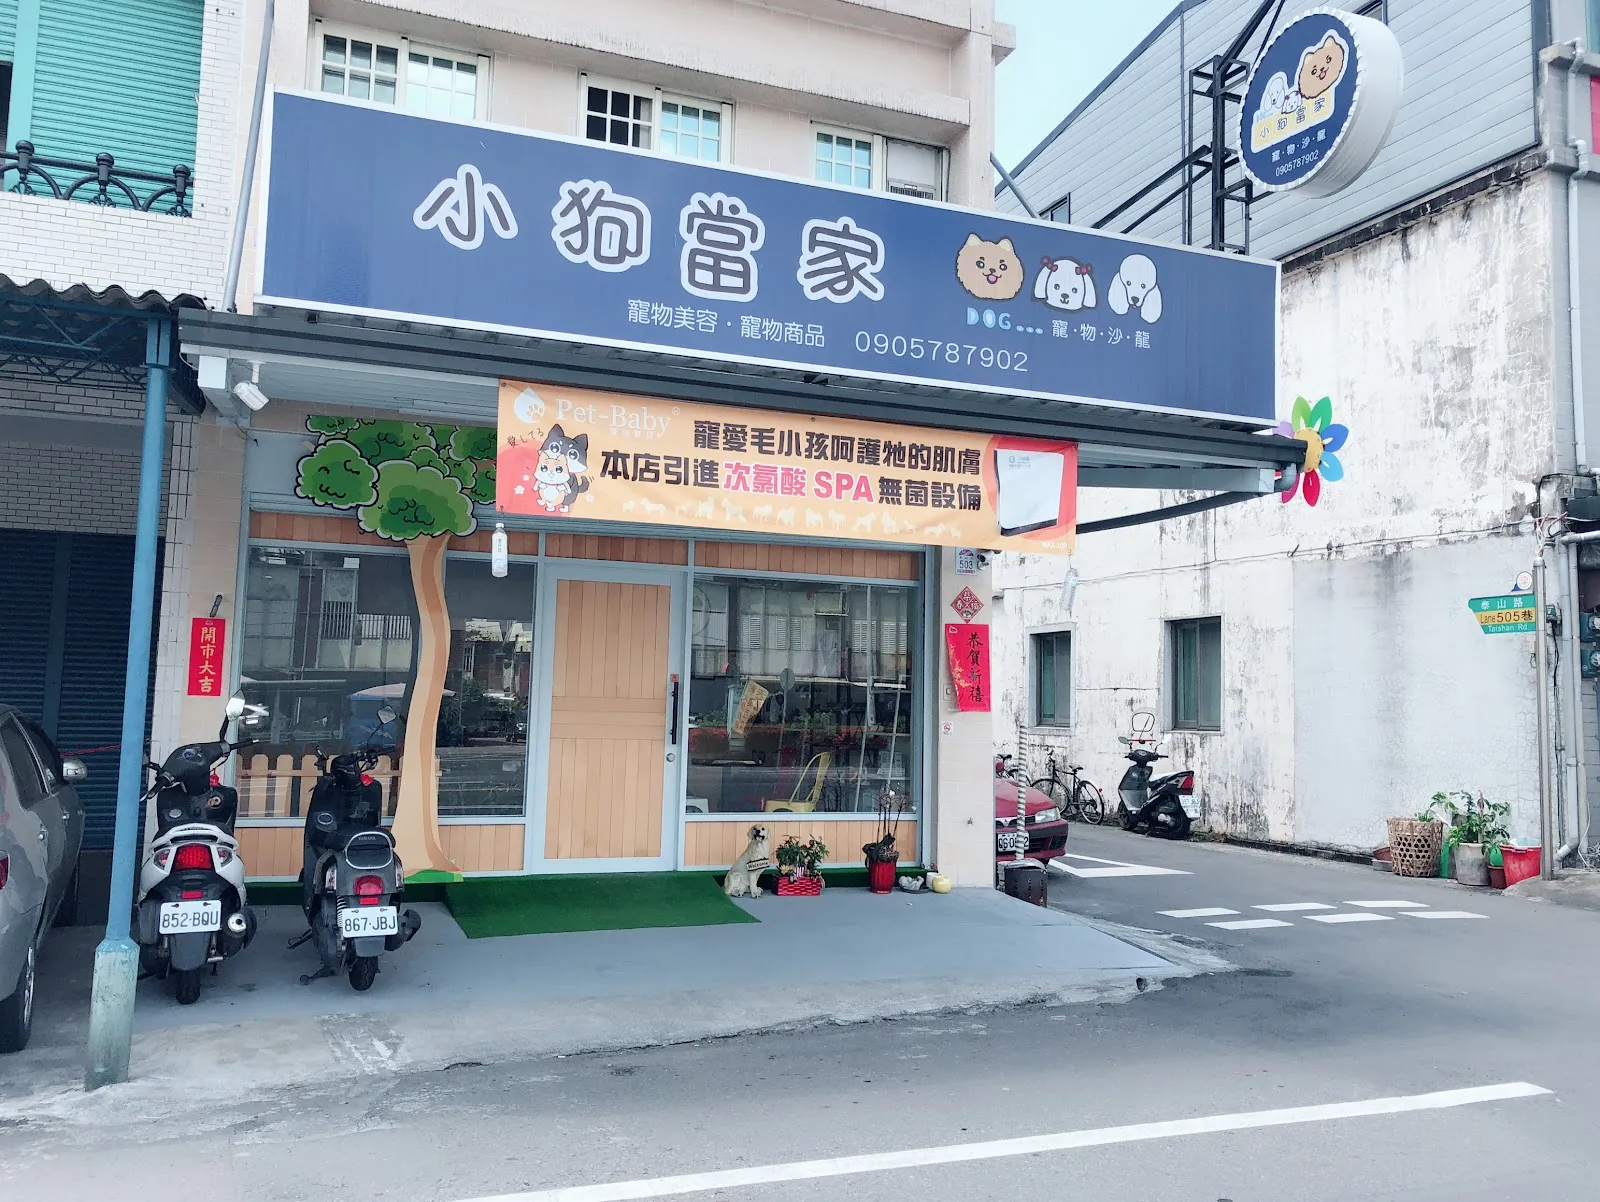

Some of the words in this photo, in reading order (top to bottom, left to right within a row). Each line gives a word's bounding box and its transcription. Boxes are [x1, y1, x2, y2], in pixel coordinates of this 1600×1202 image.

[1260, 98, 1325, 138] 小狗當家
[1276, 150, 1319, 177] 0905787902
[414, 164, 885, 302] 小狗當家
[855, 331, 1028, 371] 0905787902
[694, 420, 981, 475] 寵愛毛小孩呵護牠的肌膚
[814, 470, 874, 503] SPA
[878, 476, 981, 511] 無菌設備
[959, 559, 973, 569] 503
[1480, 613, 1496, 624] Lane
[1496, 610, 1533, 622] 505巷
[1481, 597, 1523, 611] 泰山路
[1488, 624, 1514, 632] Taishan
[198, 627, 217, 693] 開市大吉
[966, 632, 985, 702] 恭賀新禧
